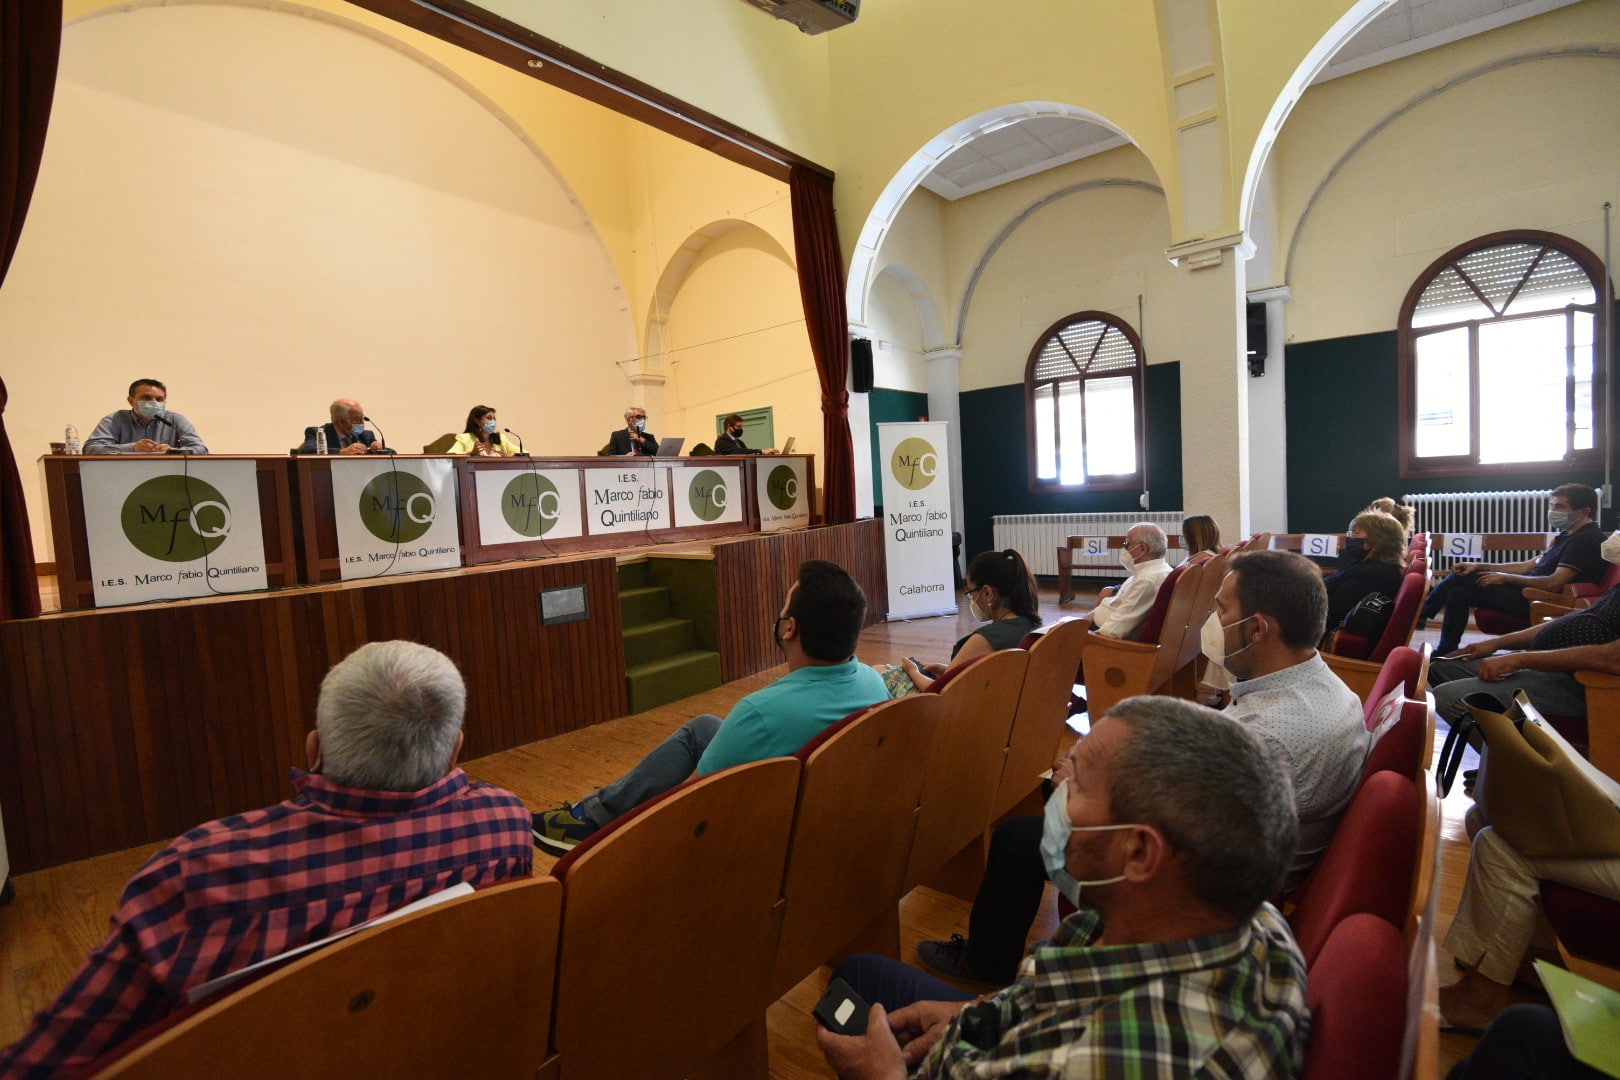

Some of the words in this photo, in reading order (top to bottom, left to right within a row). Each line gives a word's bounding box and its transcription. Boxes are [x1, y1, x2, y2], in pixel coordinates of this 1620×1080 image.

[618, 473, 639, 483] I.E.S.
[899, 452, 938, 486] MfQ
[594, 488, 634, 505] Marco
[637, 485, 663, 508] fabio
[694, 484, 728, 518] MfQ
[371, 492, 436, 538] MfQ
[510, 490, 561, 532] MfQ
[600, 508, 659, 527] Quintiliano
[889, 512, 922, 526] Marco
[924, 508, 948, 526] fabio
[138, 500, 232, 556] MfQ
[895, 527, 944, 542] Quintiliano
[345, 556, 364, 564] I.E.S.
[368, 552, 396, 563] Marco
[397, 549, 417, 563] fabio
[418, 546, 456, 558] Quintiliano
[1450, 535, 1474, 556] SÍ
[101, 578, 128, 588] I.E.S.
[135, 573, 173, 586] Marco
[177, 569, 203, 585] fabio
[207, 564, 260, 579] Quintiliano
[899, 582, 945, 596] Calahorra
